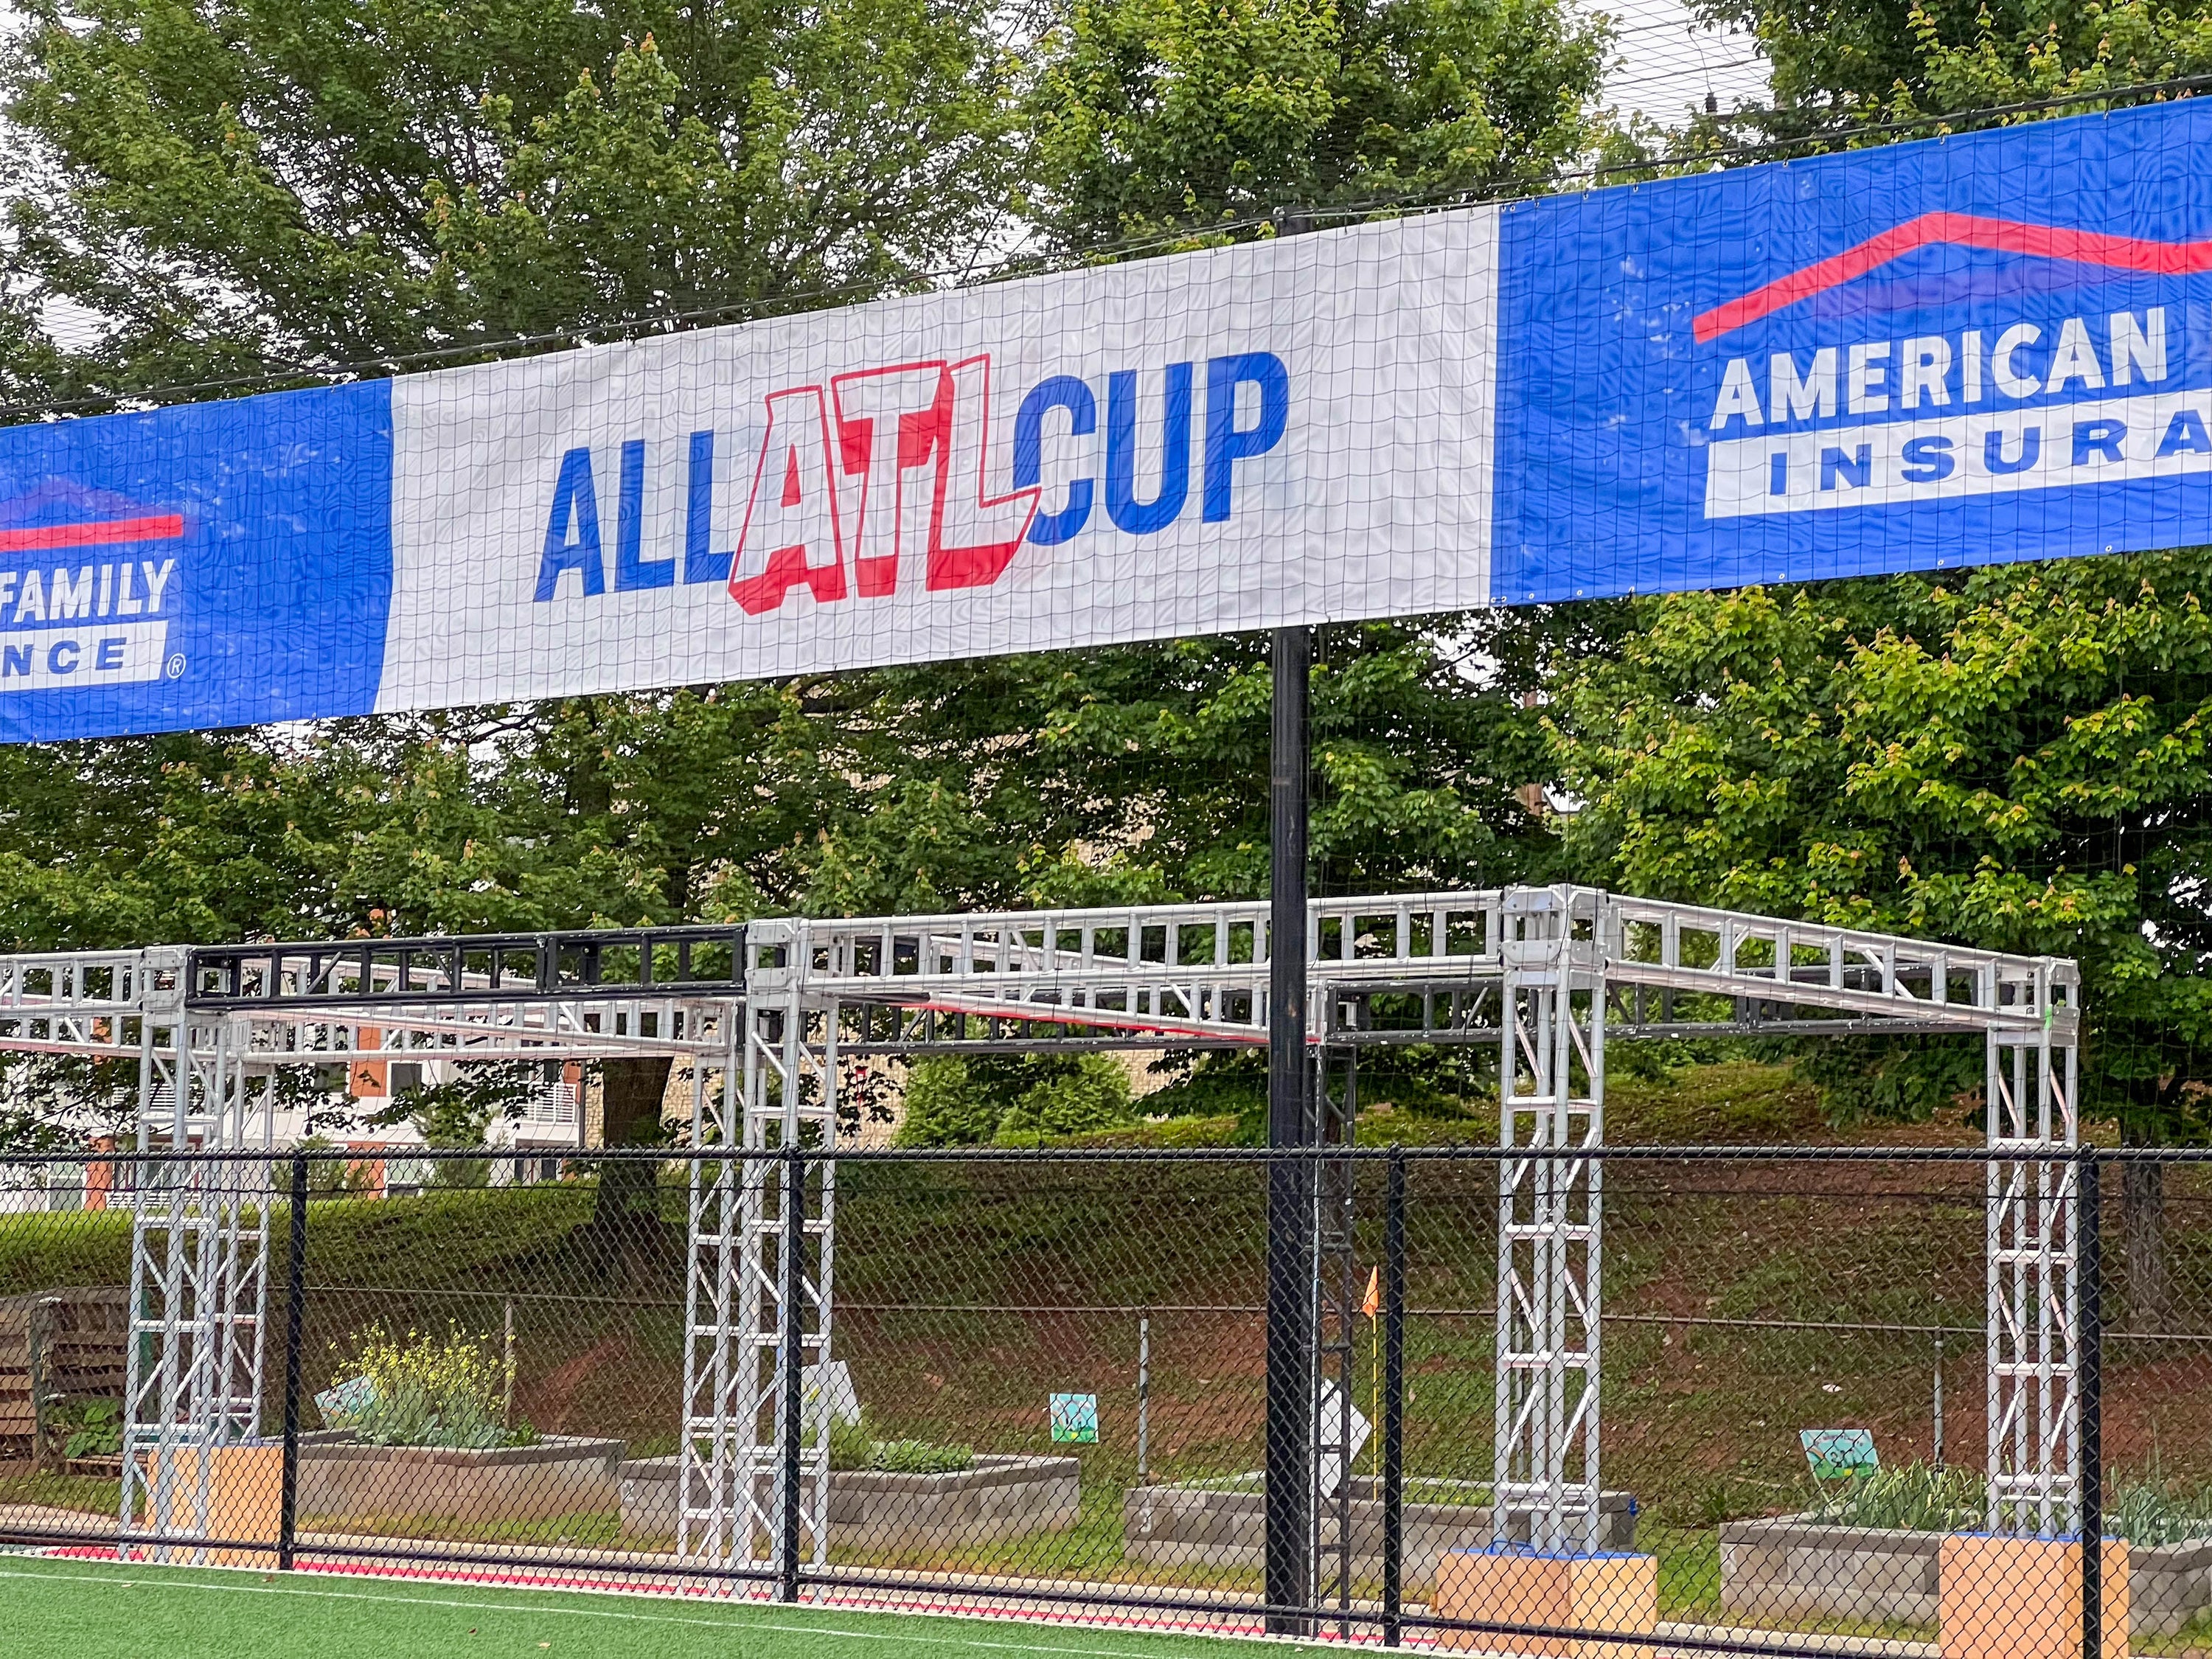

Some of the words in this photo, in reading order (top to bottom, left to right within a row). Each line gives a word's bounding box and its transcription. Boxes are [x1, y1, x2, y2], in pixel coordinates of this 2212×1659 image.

[1710, 307, 2167, 429] AMERICAN
[533, 429, 734, 602] ALL
[727, 354, 1041, 616] ATL
[1013, 351, 1289, 546] CUP
[1770, 409, 2212, 495] INSURA
[0, 558, 175, 623] FAMILY
[1, 636, 128, 678] NCE
